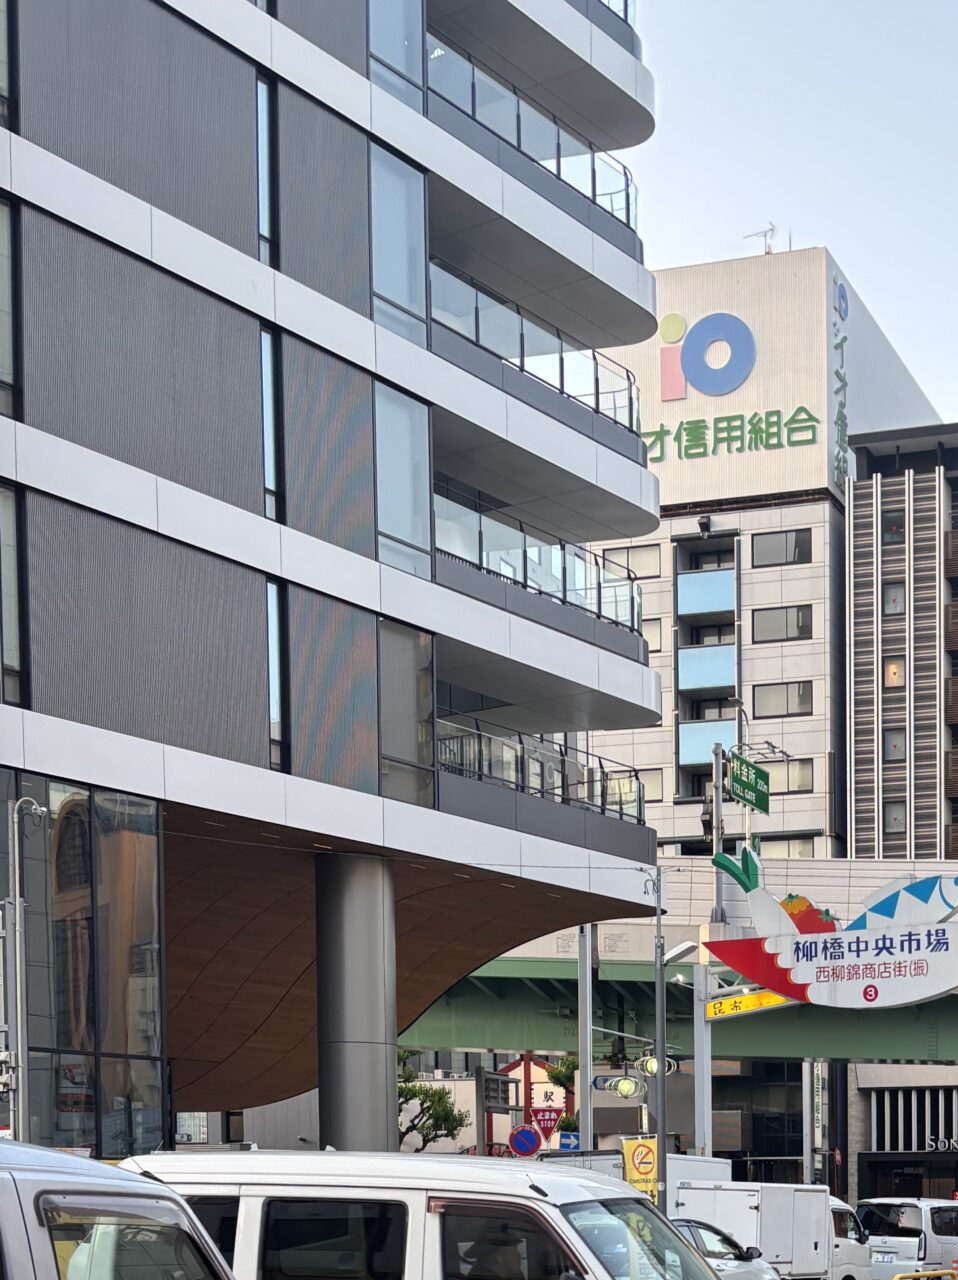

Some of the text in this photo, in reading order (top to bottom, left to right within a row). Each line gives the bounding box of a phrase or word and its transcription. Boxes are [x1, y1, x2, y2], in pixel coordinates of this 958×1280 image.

[733, 758, 756, 787] 料金所
[733, 782, 744, 797] TOLL
[793, 928, 950, 963] 柳橋中央市場
[815, 959, 929, 983] 西柳錦商店街(振)
[537, 1111, 557, 1120] 止まれ
